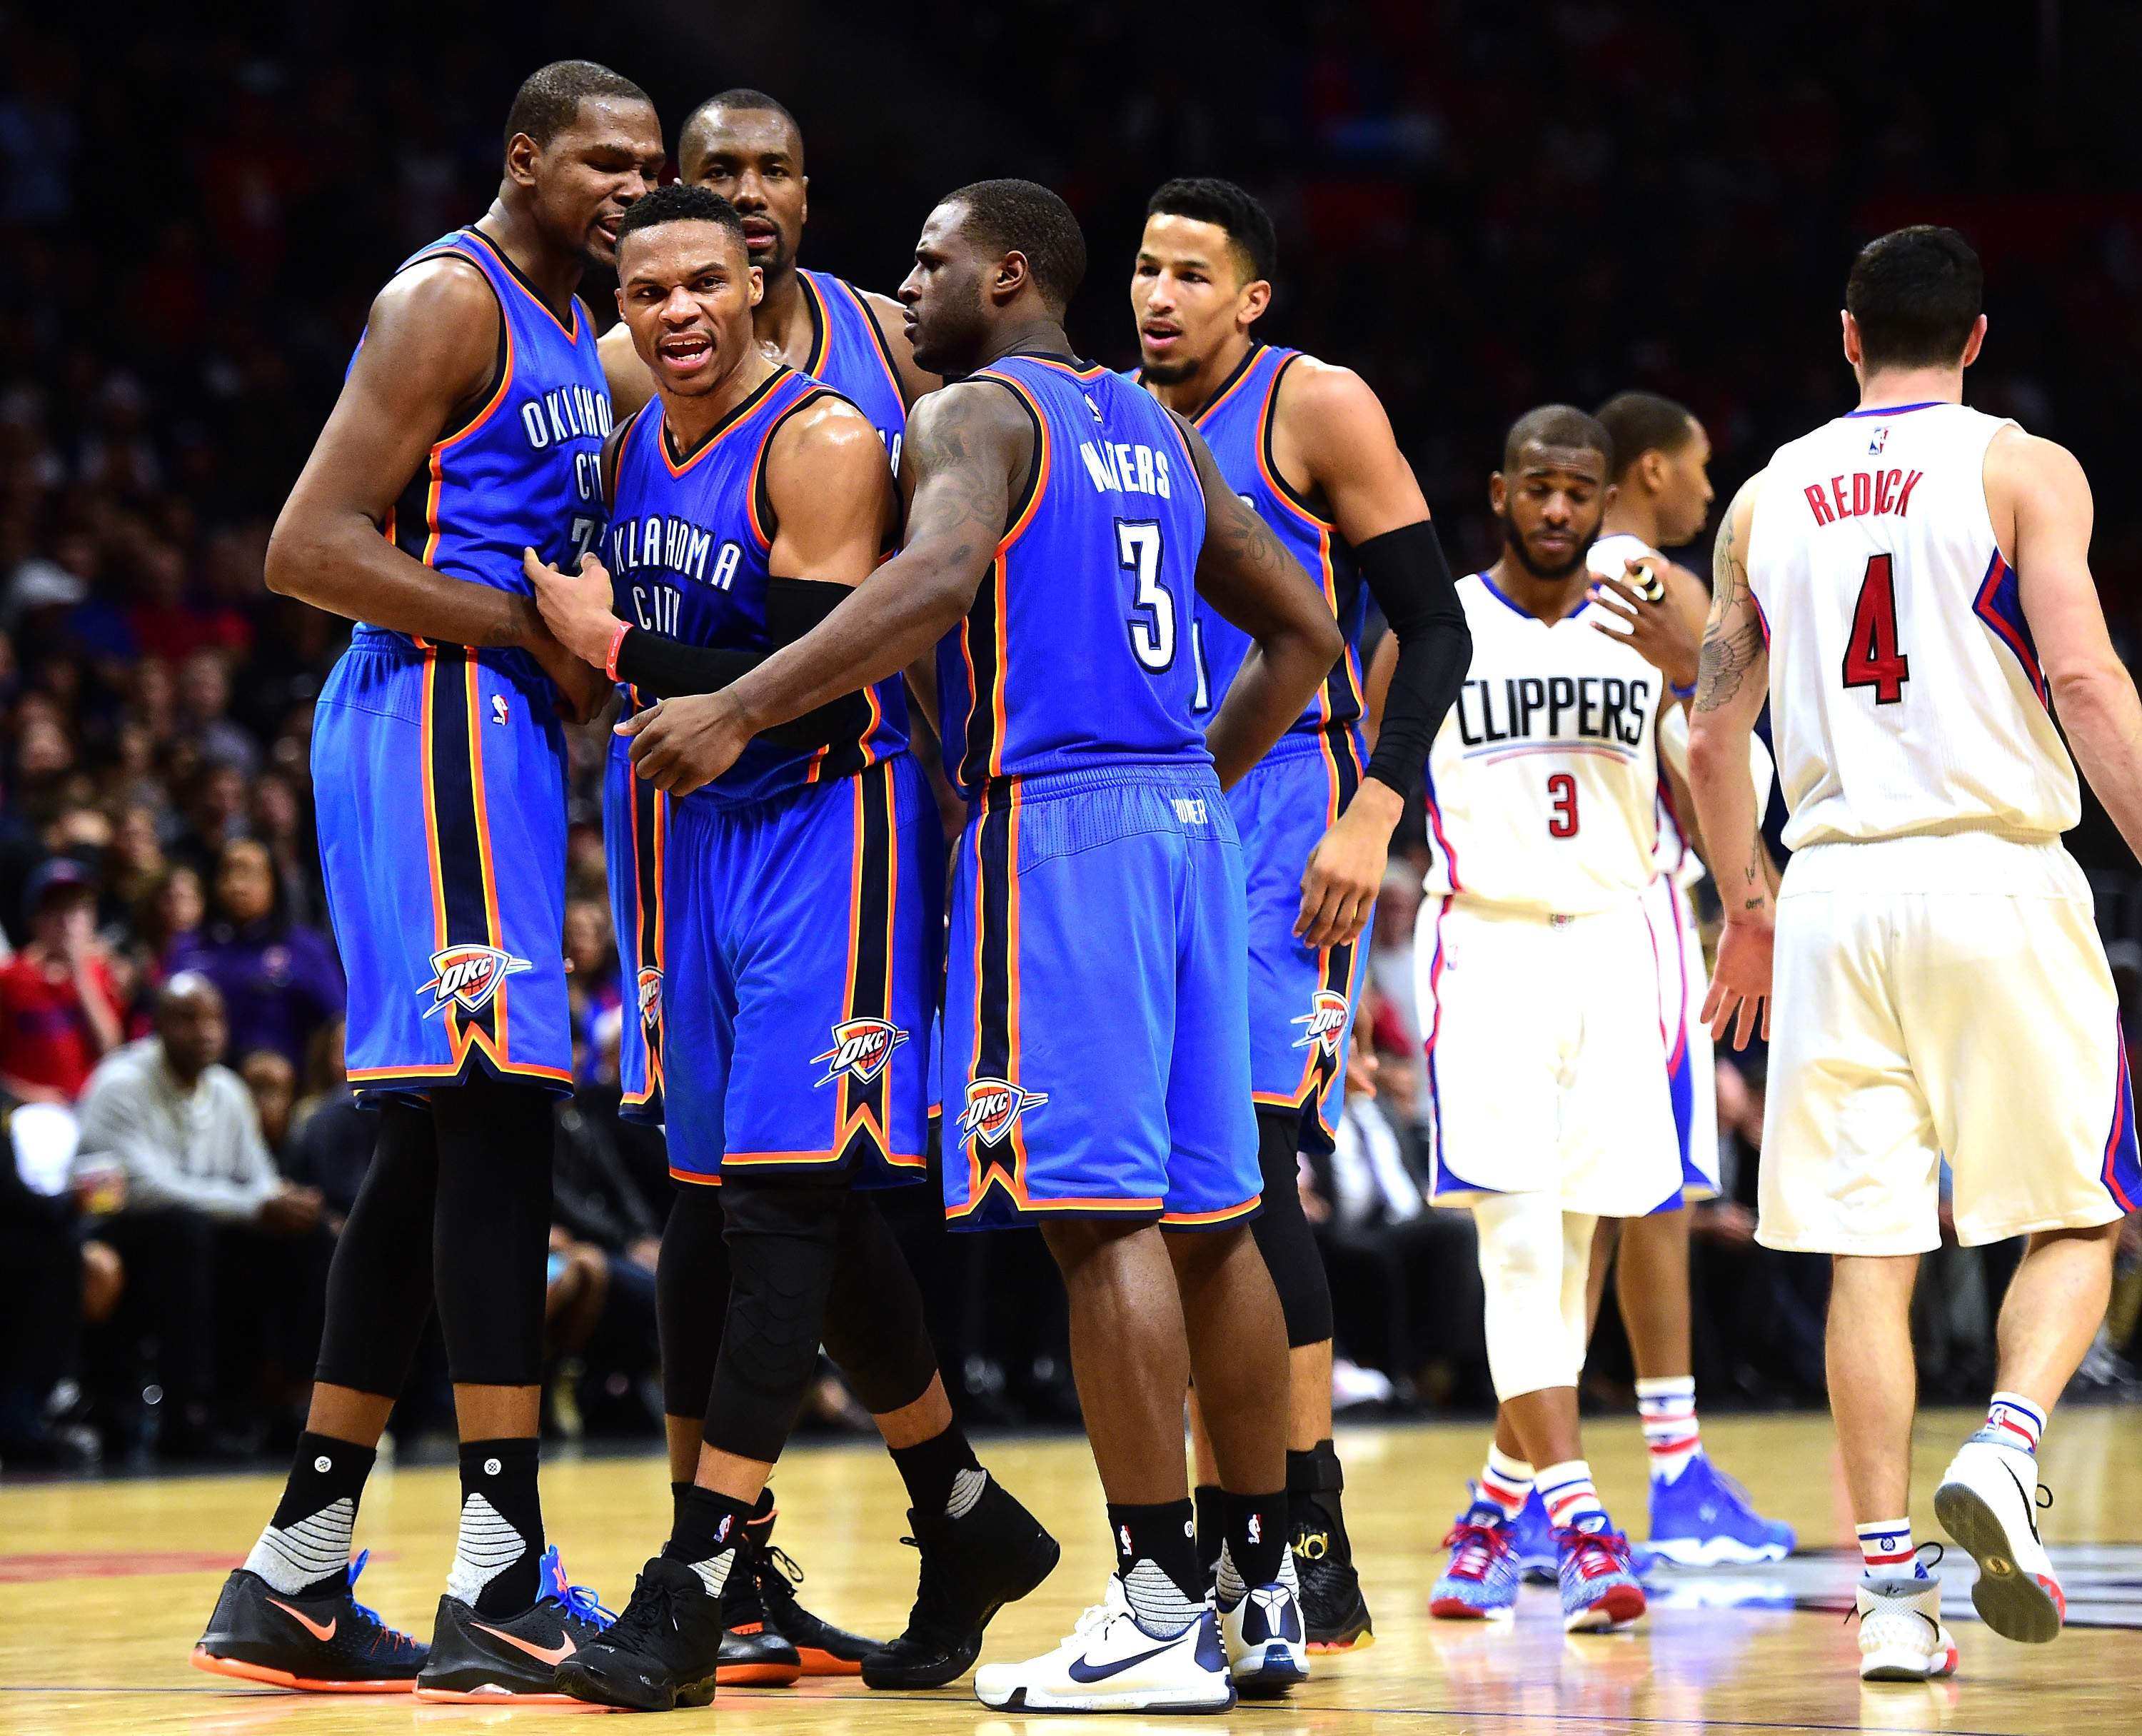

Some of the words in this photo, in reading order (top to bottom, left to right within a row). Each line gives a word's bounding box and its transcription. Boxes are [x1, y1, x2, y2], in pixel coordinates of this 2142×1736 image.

[521, 386, 613, 448] OKLAHO
[1804, 468, 1924, 527] REDICK
[614, 517, 741, 591] KLAHOMA
[633, 586, 680, 637] CITY
[1115, 518, 1175, 673] 3
[1842, 553, 1910, 705] 4
[1457, 677, 1649, 746] CLIPPERS
[1547, 773, 1579, 838] 3
[437, 956, 494, 1000] OKC
[831, 1030, 885, 1072] OKC
[1308, 1007, 1345, 1035] OKC
[964, 1091, 1009, 1134] OKC
